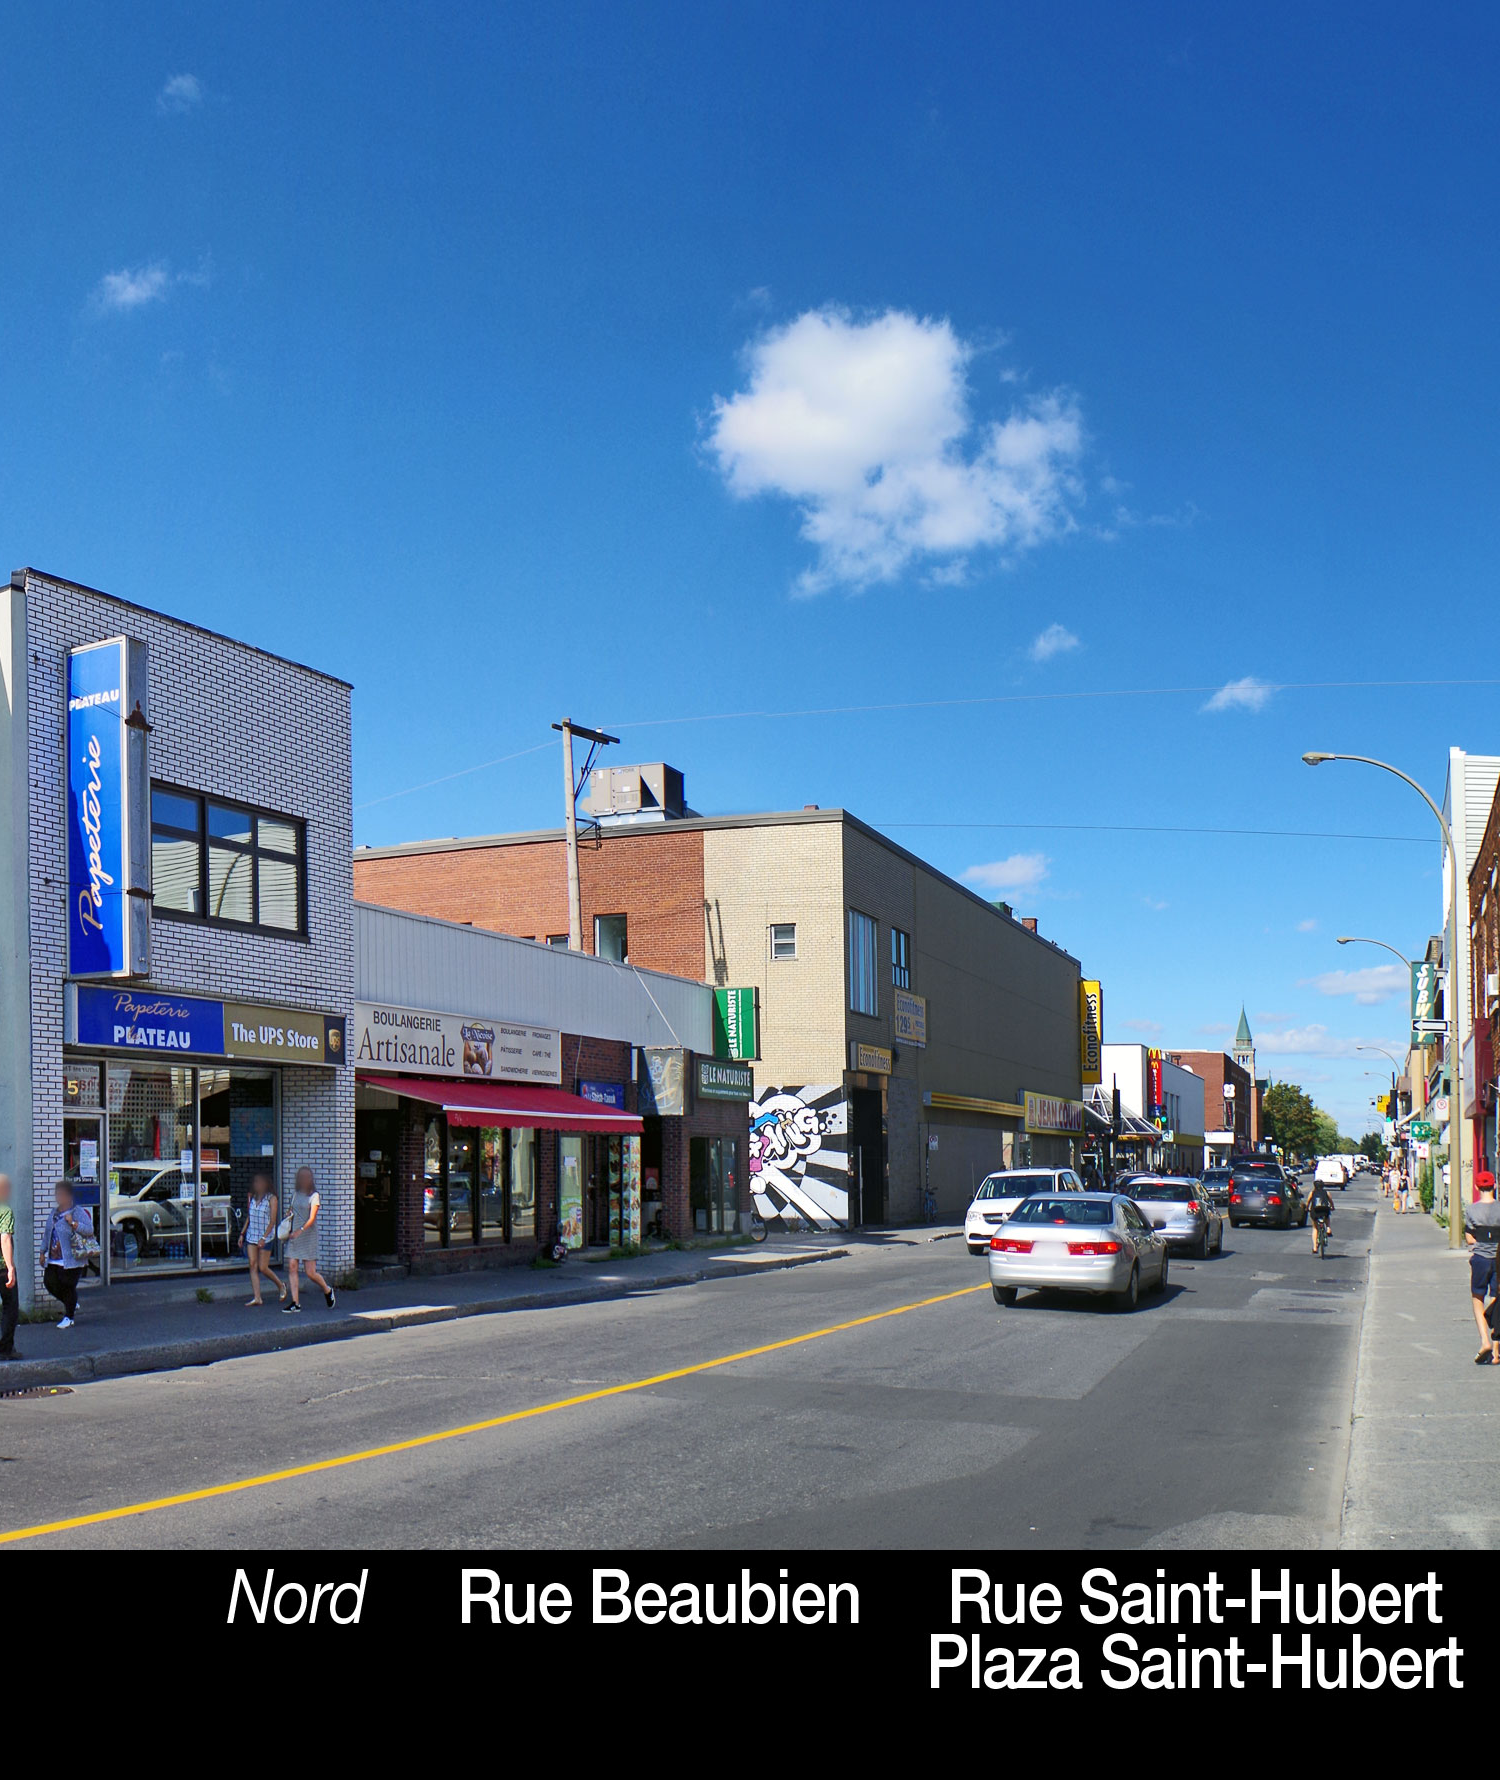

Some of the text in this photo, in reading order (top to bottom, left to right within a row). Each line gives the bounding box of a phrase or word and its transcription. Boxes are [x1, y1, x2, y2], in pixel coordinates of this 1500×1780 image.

[69, 689, 119, 712] PLATEAU
[78, 735, 115, 937] Papeterie
[113, 993, 190, 1021] Papeterie
[1416, 964, 1431, 1043] SUBWY
[373, 1010, 441, 1032] BOULANGERIE
[727, 990, 737, 1047] LE NATURISTE
[1082, 993, 1098, 1072] Econofitness
[114, 1025, 191, 1049] PLATEAU
[232, 1022, 319, 1050] The UPS Store
[357, 1027, 455, 1068] Artisanale
[501, 1027, 551, 1040] BOULANGERIE FROMAGES
[501, 1045, 522, 1054] PÂTISSERIE
[501, 1066, 529, 1075] SANDWICHERIE
[710, 1066, 750, 1086] LE NATURISTE
[1037, 1098, 1058, 1127] JEAN
[1059, 1101, 1082, 1130] COUTU
